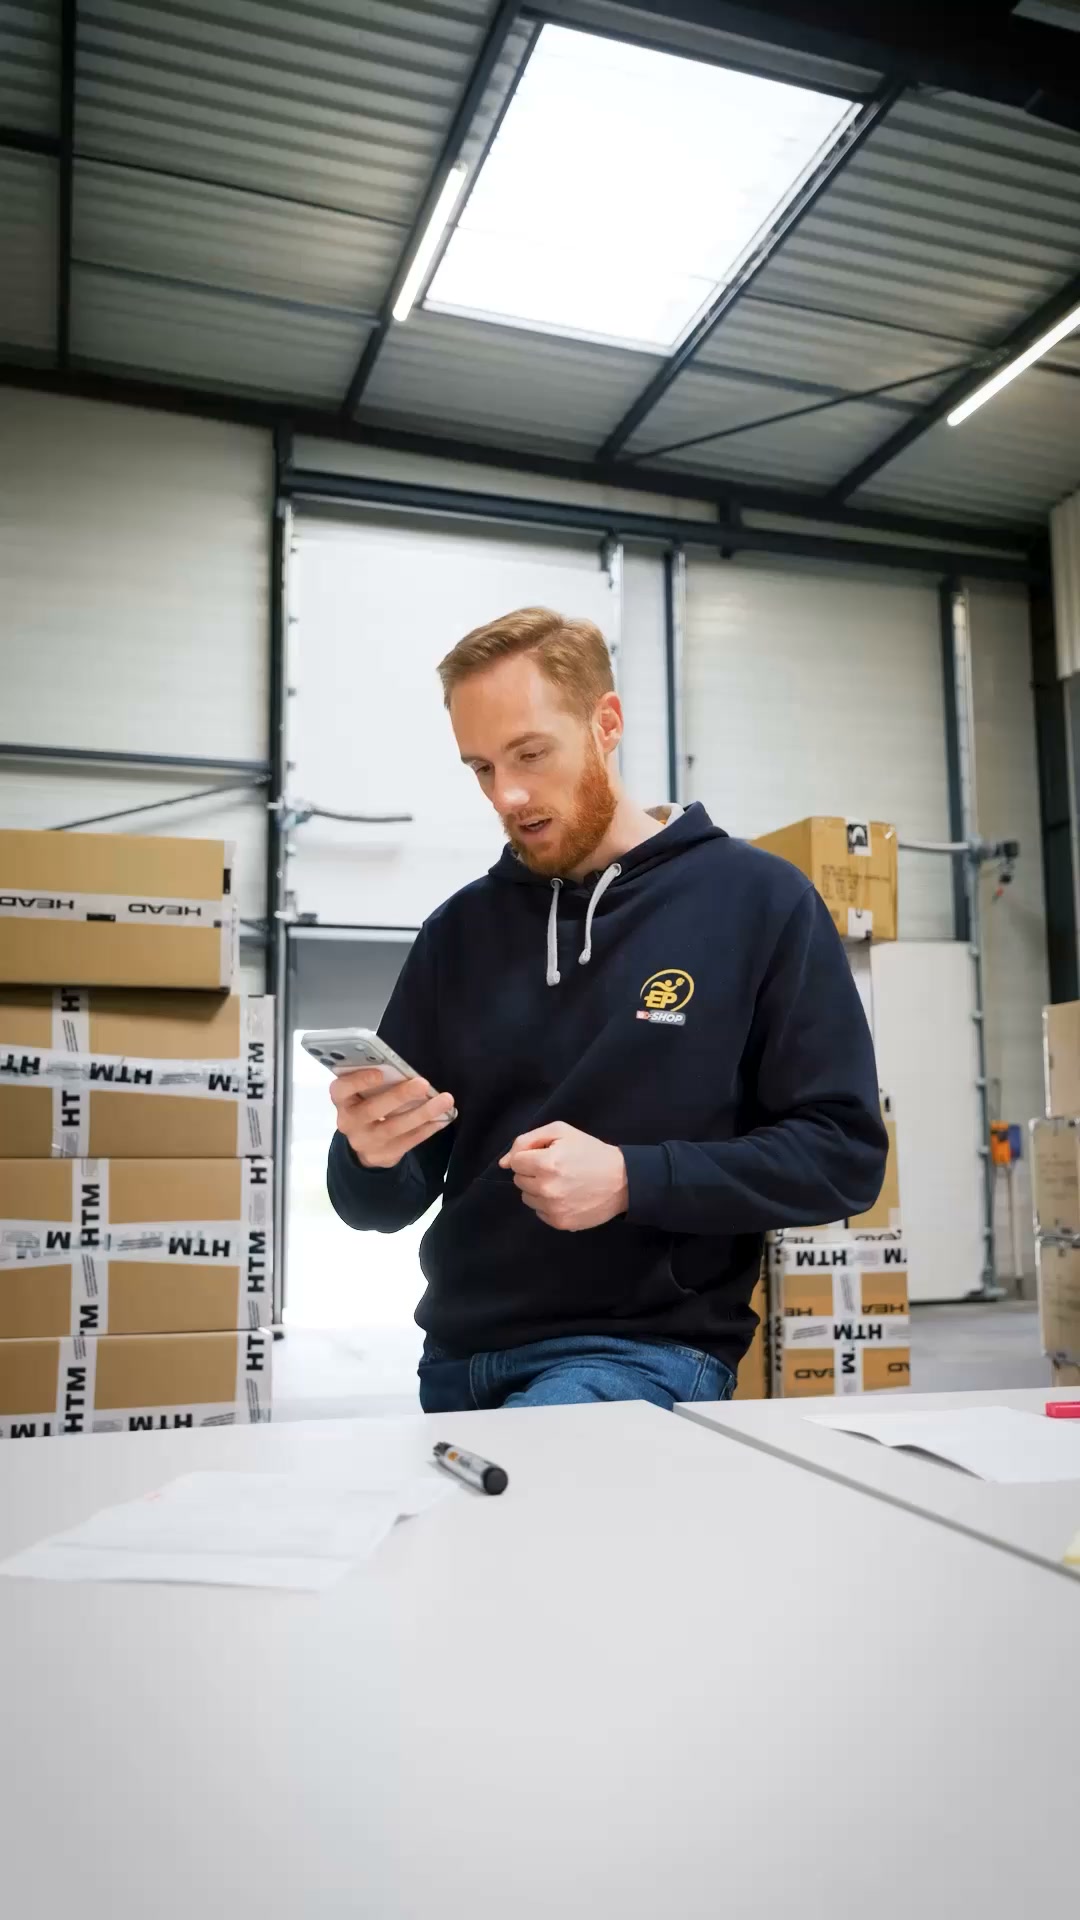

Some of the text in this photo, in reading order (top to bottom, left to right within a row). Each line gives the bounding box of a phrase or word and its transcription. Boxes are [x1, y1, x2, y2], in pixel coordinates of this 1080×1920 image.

[128, 903, 201, 916] HEAD
[61, 988, 80, 1012] H
[644, 990, 678, 1009] EP
[651, 1012, 684, 1023] SHOP
[90, 1062, 153, 1086] HTM
[81, 1184, 100, 1247] HTM
[168, 1237, 231, 1258] HTM
[247, 1231, 266, 1293] HTM
[796, 1250, 847, 1267] HTM
[833, 1324, 882, 1340] HTM
[64, 1367, 86, 1433] HTM
